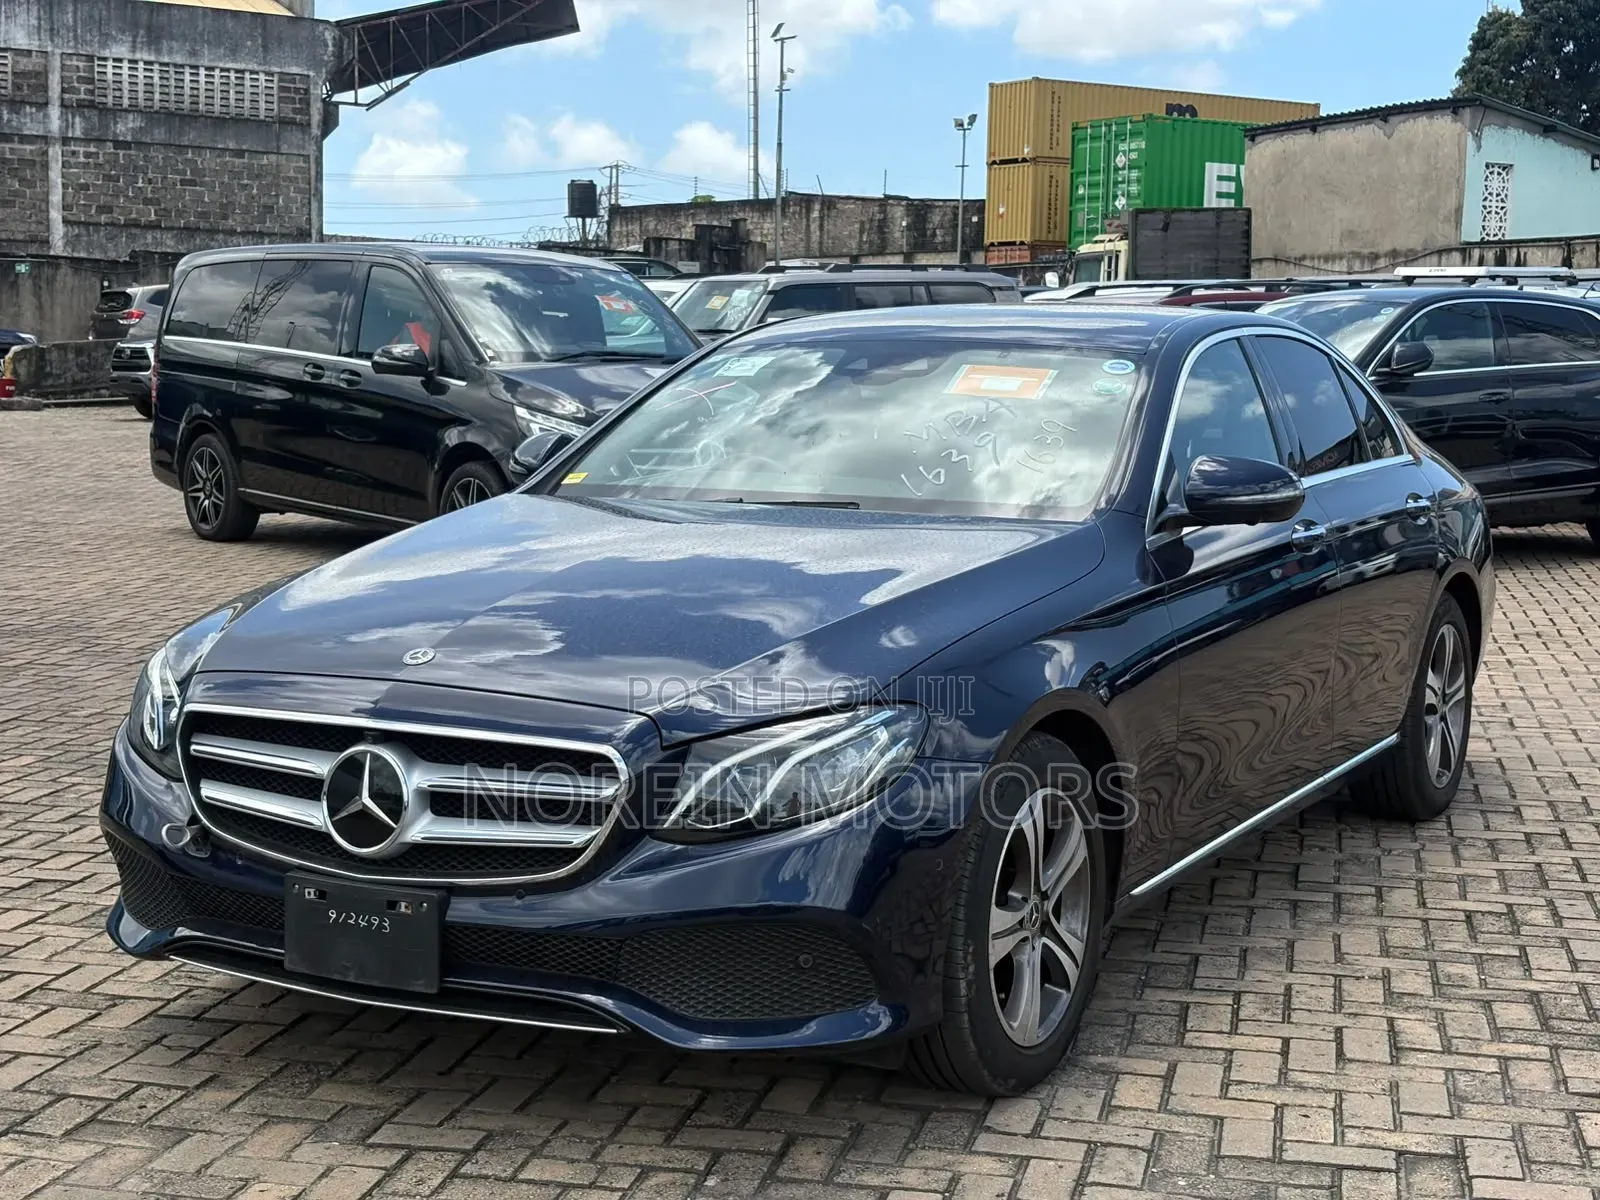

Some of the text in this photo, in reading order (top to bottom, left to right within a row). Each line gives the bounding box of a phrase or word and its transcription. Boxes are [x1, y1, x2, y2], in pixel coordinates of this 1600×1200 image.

[1203, 162, 1244, 208] E
[900, 430, 1000, 496] 1639
[328, 909, 391, 933] 912493
